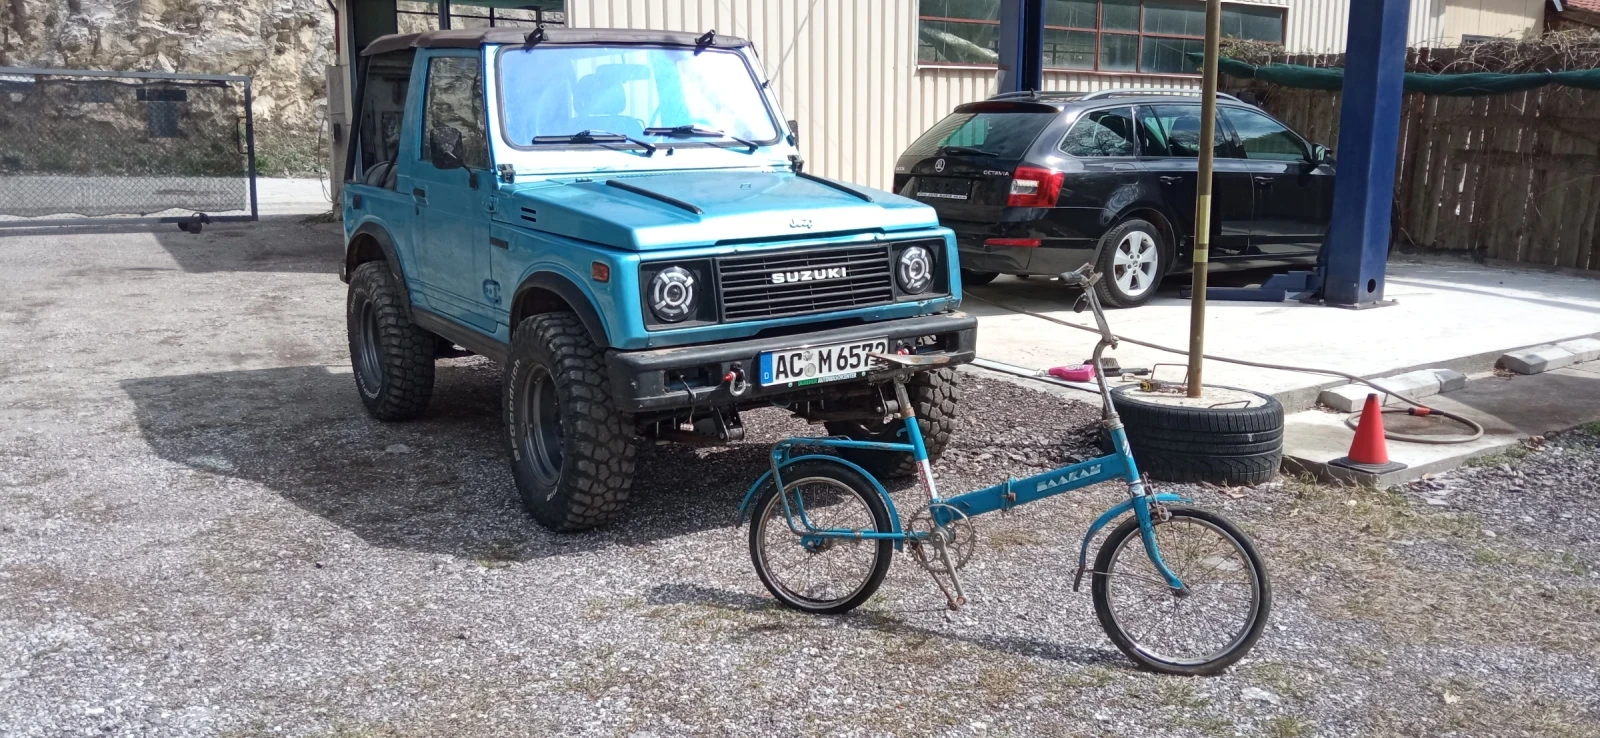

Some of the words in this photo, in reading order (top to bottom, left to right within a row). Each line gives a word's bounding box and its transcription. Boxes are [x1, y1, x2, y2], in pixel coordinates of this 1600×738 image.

[771, 267, 847, 284] SUZUKI
[763, 372, 770, 380] D
[775, 352, 804, 380] AC
[818, 349, 832, 374] M
[509, 359, 521, 462] BFGoodrich
